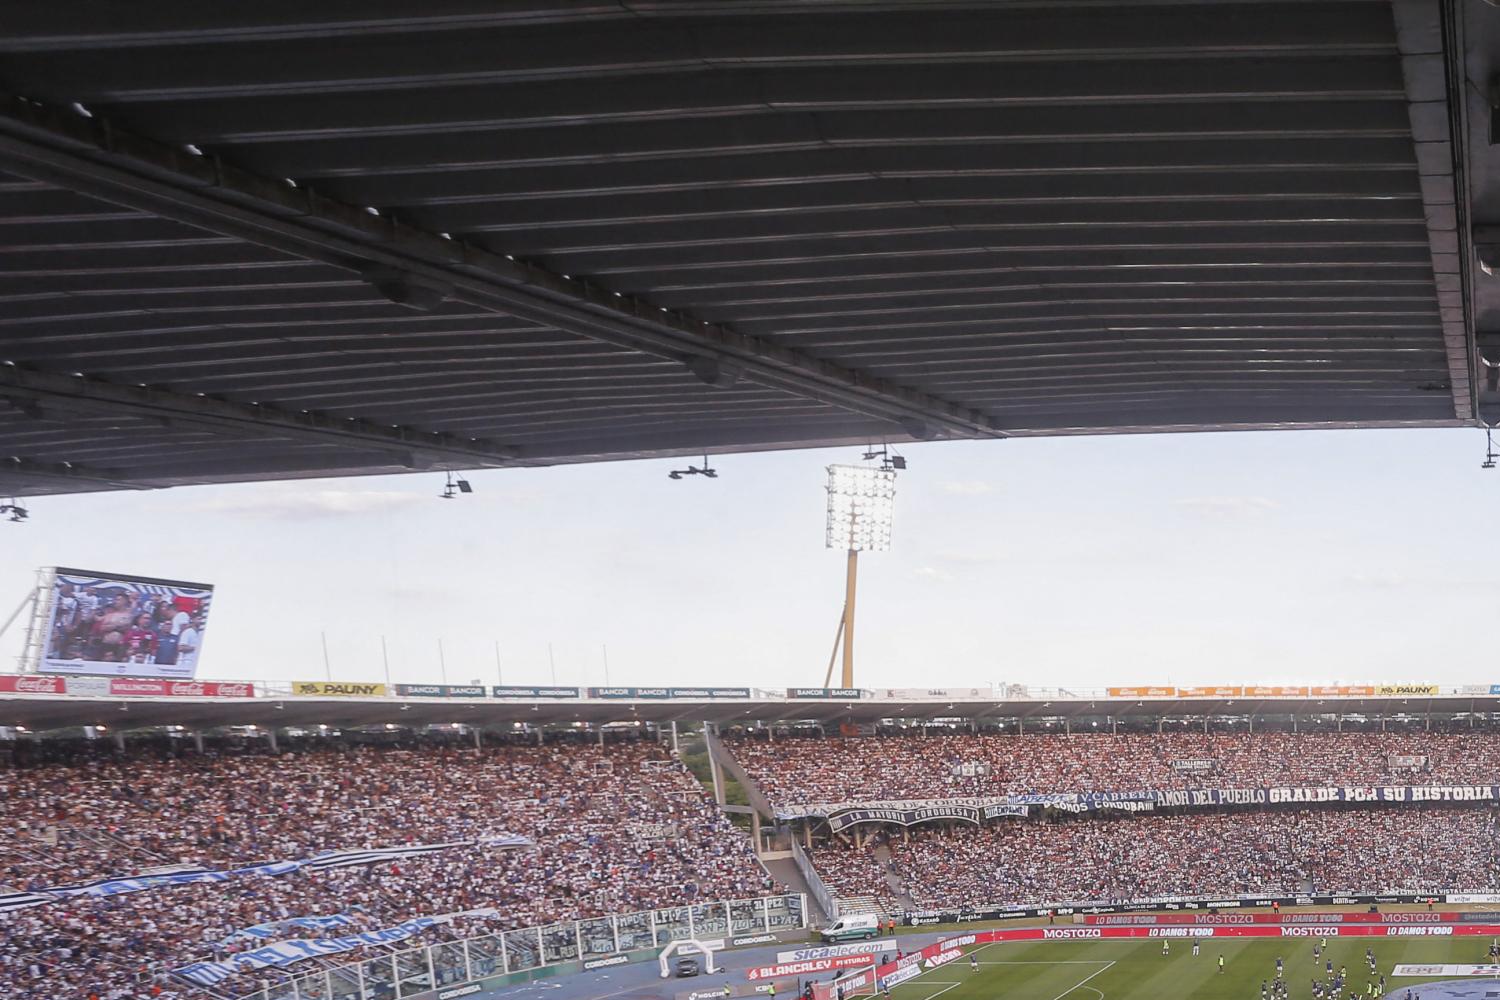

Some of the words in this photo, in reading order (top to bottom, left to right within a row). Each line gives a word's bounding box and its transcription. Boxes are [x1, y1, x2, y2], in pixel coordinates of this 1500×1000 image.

[323, 684, 377, 695] PAUNY
[408, 686, 439, 694] BANCOR
[450, 687, 482, 695] BANCOR
[638, 688, 667, 696] BANCOR
[831, 689, 858, 697] BANCOR
[1396, 686, 1432, 695] PAUNY
[1191, 790, 1216, 805] DEL
[1218, 789, 1265, 804] PUEBLO
[1269, 787, 1339, 802] GRANDE
[1344, 786, 1381, 801] POR
[1384, 786, 1406, 801] SU
[1411, 786, 1493, 800] HISTORIA
[1149, 927, 1158, 936] LO
[1159, 927, 1188, 936] DAMOS
[1387, 926, 1396, 935] LO
[1398, 926, 1426, 935] DAMOS
[794, 943, 882, 961] sicaelec.com
[760, 960, 831, 977] BLANCALEY
